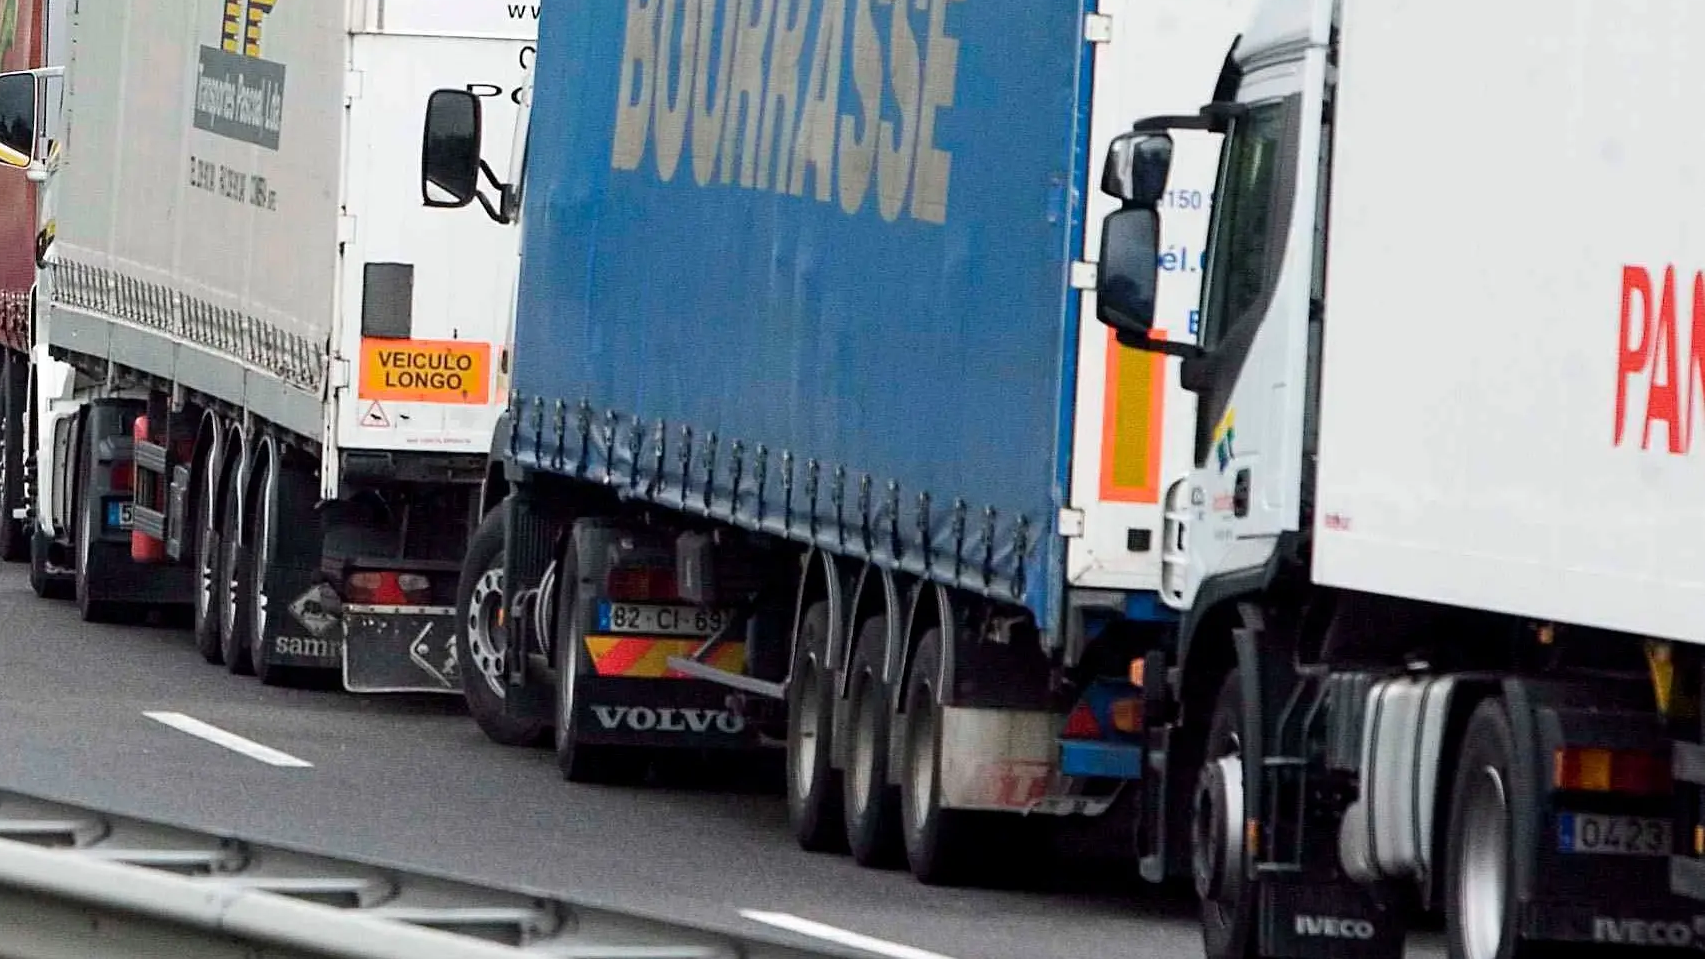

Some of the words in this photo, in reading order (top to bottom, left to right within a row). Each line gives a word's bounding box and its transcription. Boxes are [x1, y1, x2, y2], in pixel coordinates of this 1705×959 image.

[378, 350, 473, 371] VEICULO
[385, 371, 463, 390] LONGO
[590, 704, 745, 734] VOLVO
[1295, 914, 1375, 939] IVECO
[1593, 917, 1693, 945] IVECO
